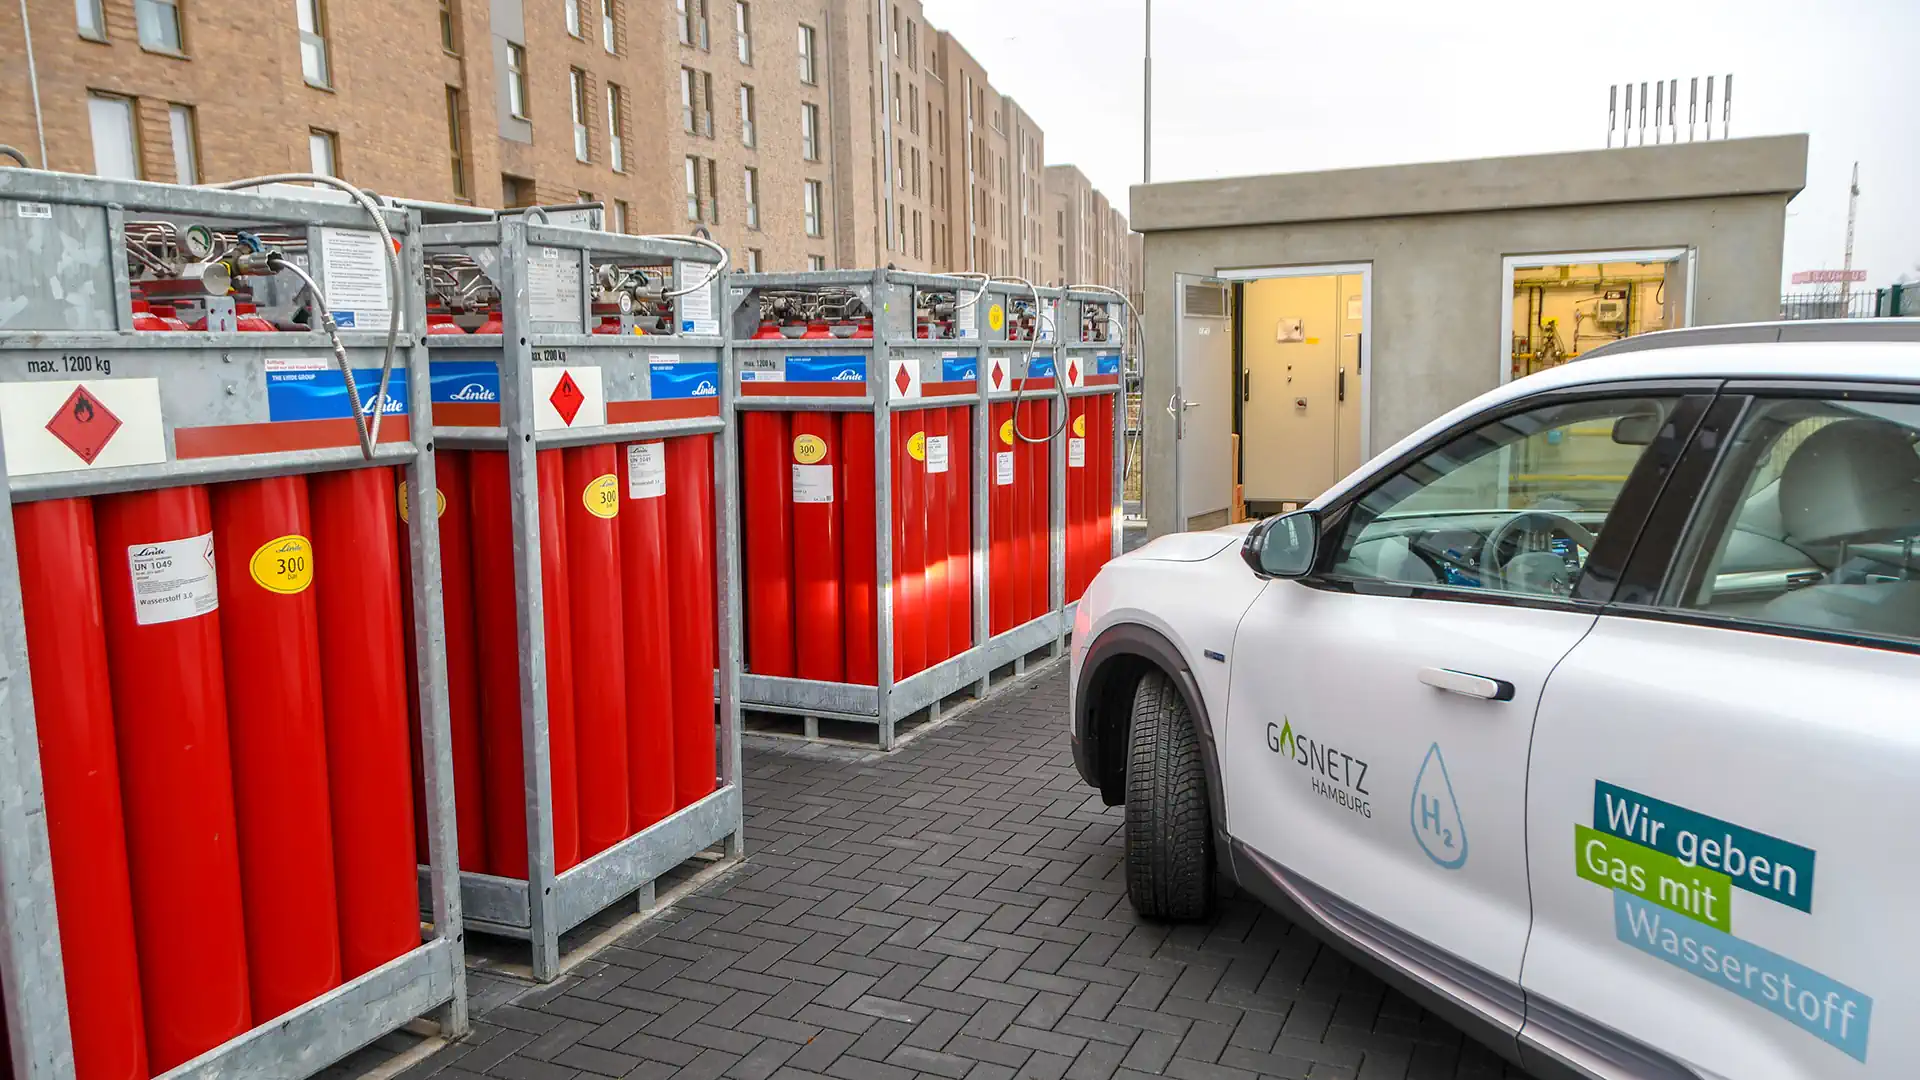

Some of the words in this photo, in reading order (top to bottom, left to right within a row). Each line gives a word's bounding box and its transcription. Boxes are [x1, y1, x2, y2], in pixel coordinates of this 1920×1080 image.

[544, 349, 557, 361] 1200
[558, 349, 566, 362] kg
[28, 360, 58, 373] max.
[62, 356, 92, 372] 1200
[96, 356, 111, 375] kg
[832, 369, 863, 381] Linde
[450, 383, 496, 400] Linde
[691, 380, 717, 395] Linde
[800, 445, 815, 453] 300
[600, 490, 616, 504] 300
[133, 547, 165, 557] Linde
[134, 563, 147, 571] UN
[151, 560, 172, 569] 1049
[277, 556, 304, 574] 300
[140, 593, 181, 606] Wasserstoff
[1311, 777, 1371, 818] HAMBURG
[1605, 793, 1665, 846] Wir
[1677, 830, 1797, 896] geben
[1585, 839, 1646, 892] Gas
[1659, 875, 1718, 922] mit
[1625, 901, 1857, 1040] Wasserstoff
